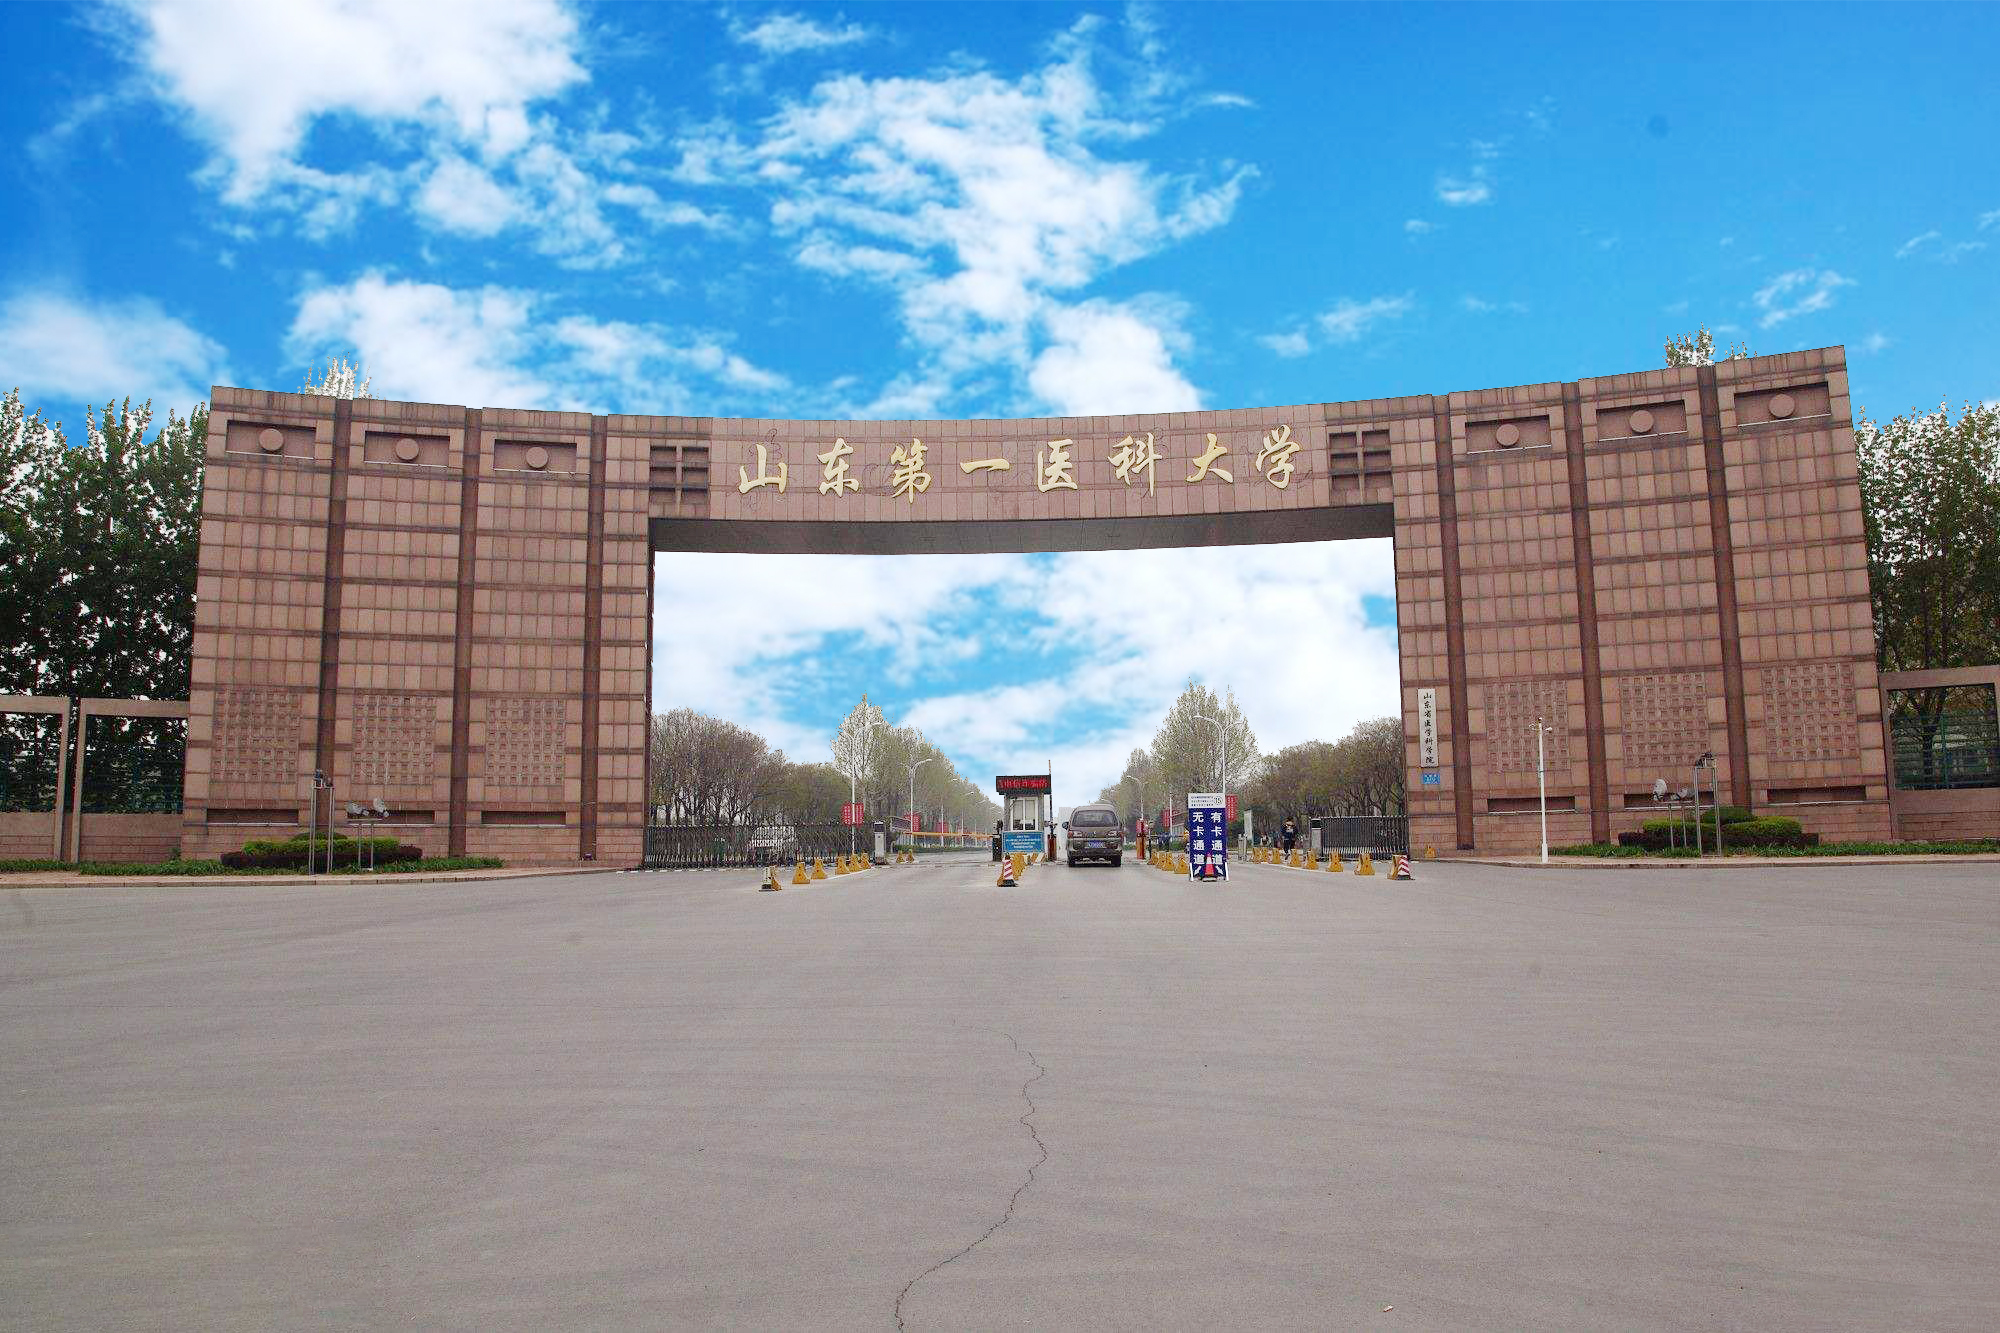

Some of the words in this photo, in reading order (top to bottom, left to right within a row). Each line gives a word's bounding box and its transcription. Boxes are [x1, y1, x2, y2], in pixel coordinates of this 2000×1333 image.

[739, 424, 1300, 503] 山东第一医科大学
[1423, 692, 1435, 764] 山东省医学科学院
[1192, 811, 1205, 865] 无卡通道
[1211, 811, 1224, 865] 有卡通道
